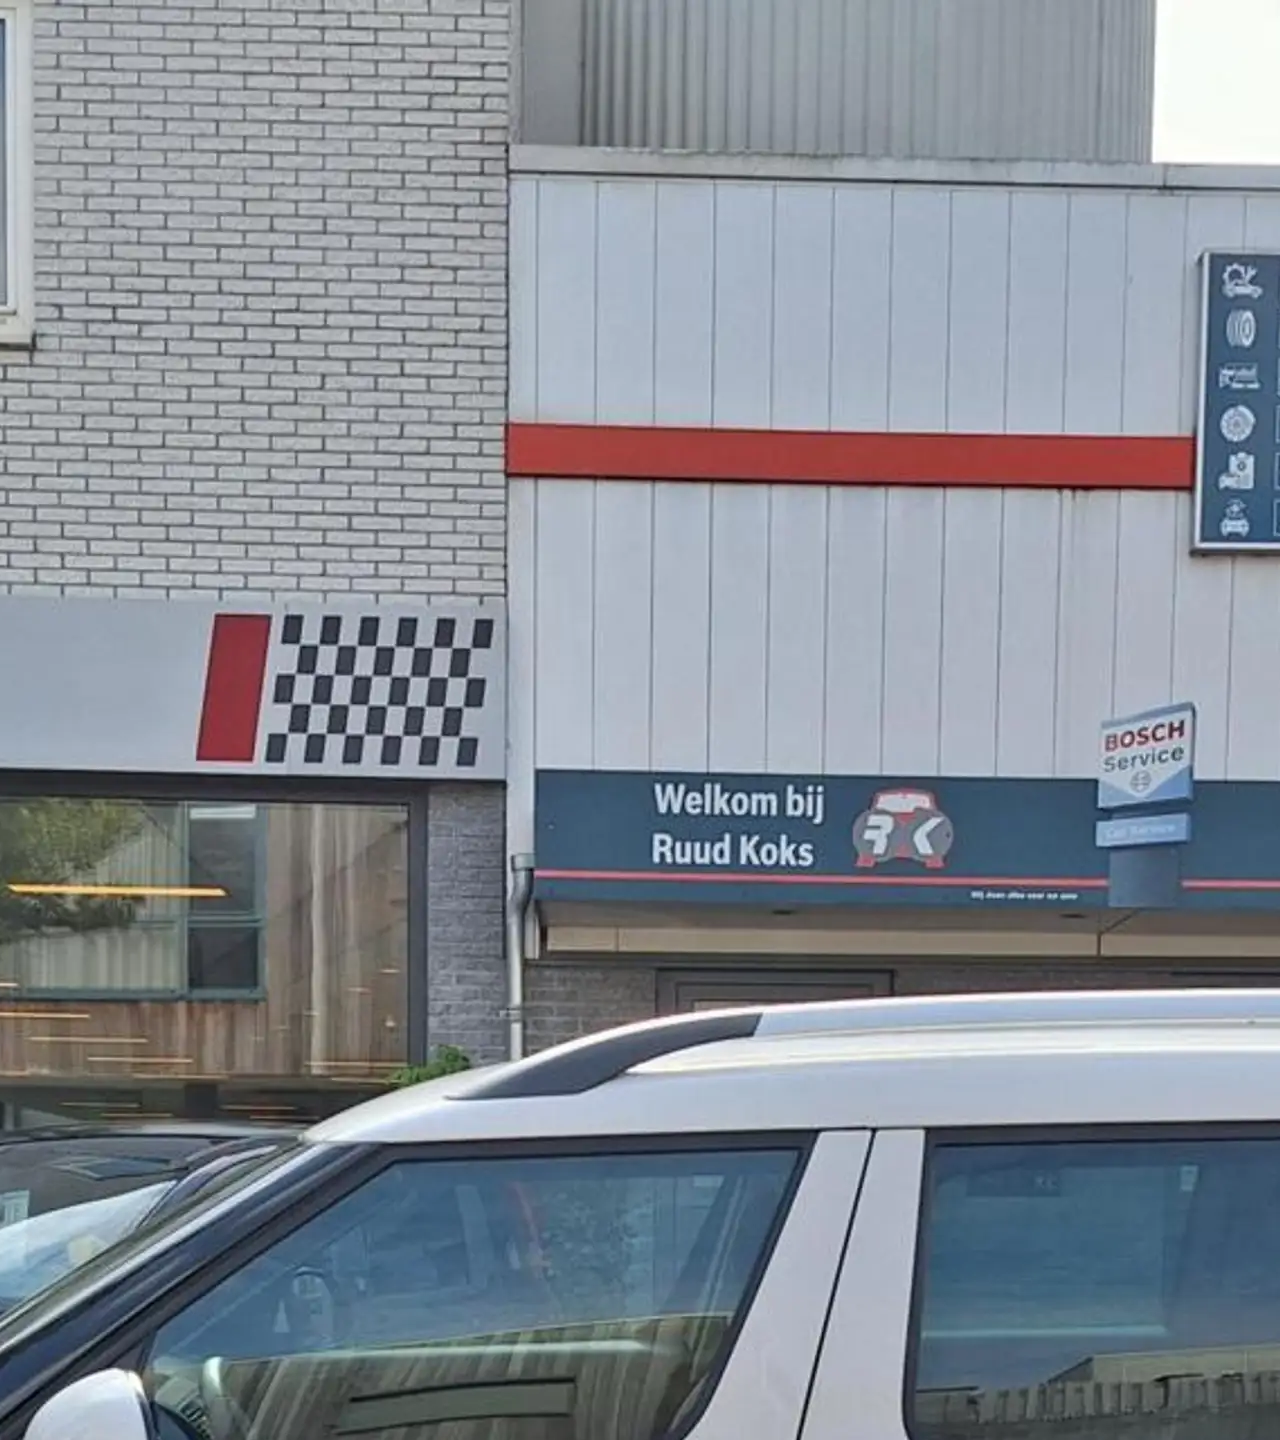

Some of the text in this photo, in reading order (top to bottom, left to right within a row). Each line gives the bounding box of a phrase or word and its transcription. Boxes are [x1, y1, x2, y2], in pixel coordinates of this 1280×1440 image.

[1104, 719, 1185, 752] BOSCH
[1102, 745, 1185, 773] Service
[653, 783, 824, 824] Welkom bij
[651, 832, 814, 867] Ruud Koks
